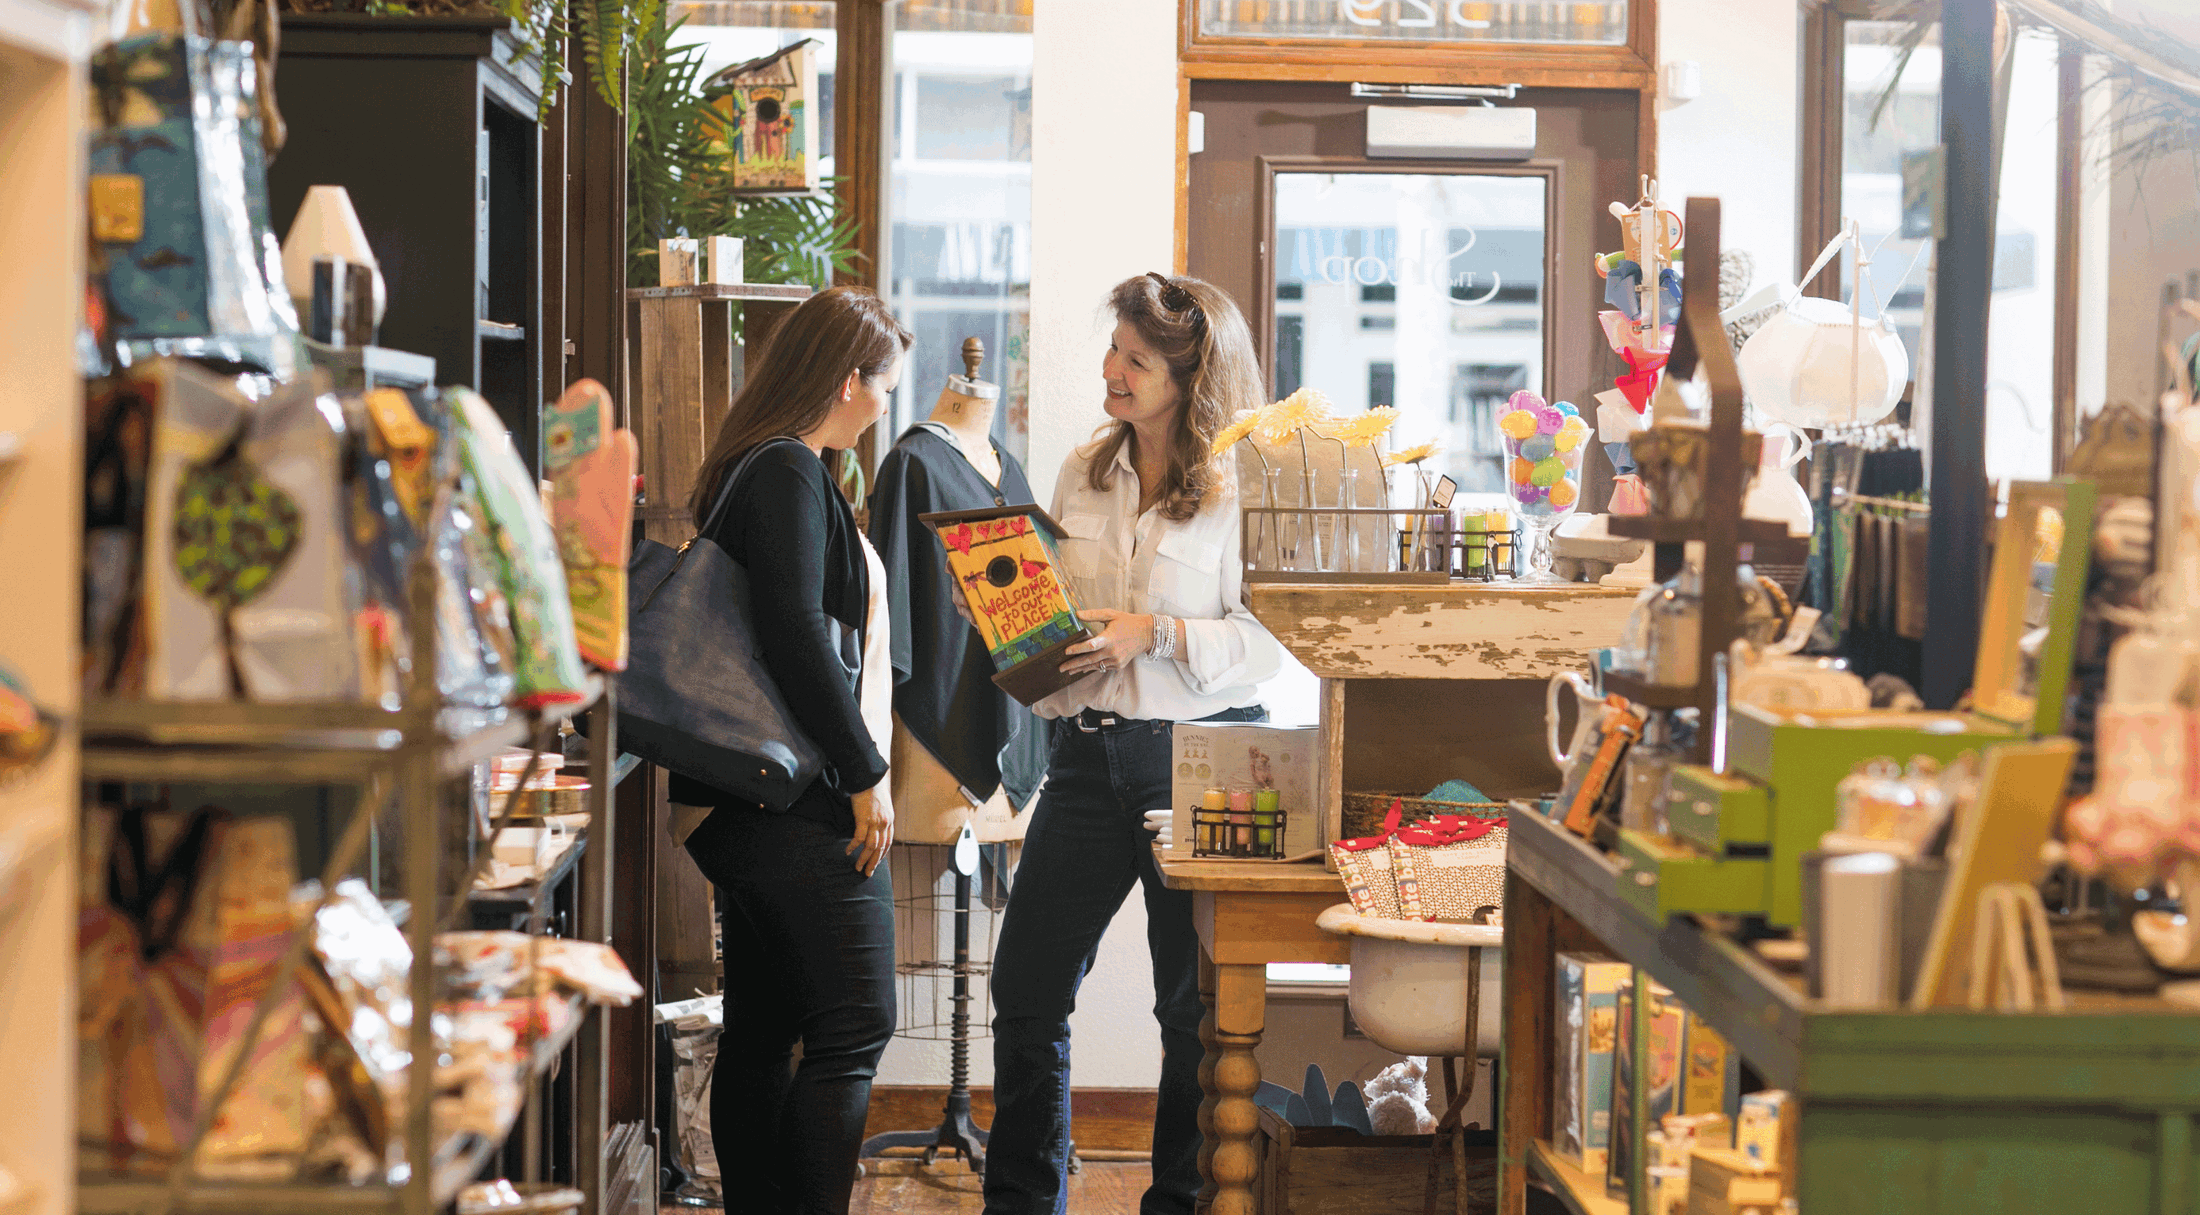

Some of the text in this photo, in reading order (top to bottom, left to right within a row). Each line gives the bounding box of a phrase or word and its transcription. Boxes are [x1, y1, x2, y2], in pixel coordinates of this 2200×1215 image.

[952, 402, 961, 414] 12
[1002, 608, 1019, 622] to
[1001, 604, 1052, 641] PLACE
